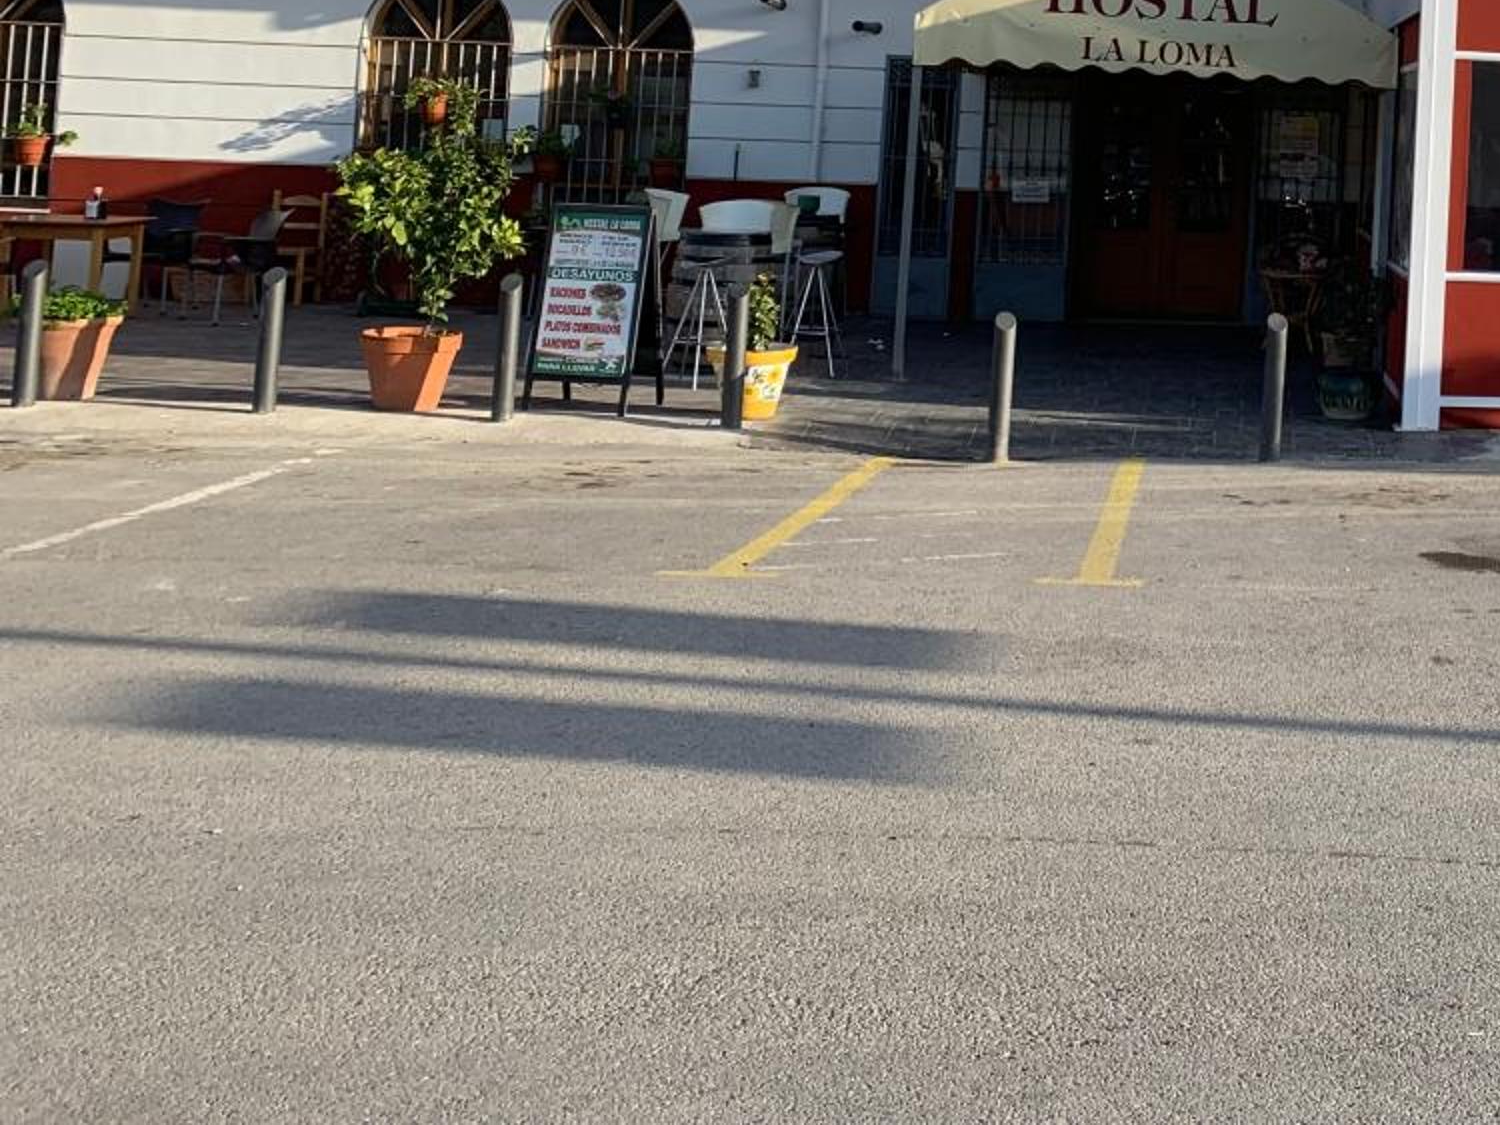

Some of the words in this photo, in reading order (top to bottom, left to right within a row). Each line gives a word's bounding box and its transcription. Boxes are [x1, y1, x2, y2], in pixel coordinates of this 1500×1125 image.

[1080, 36, 1125, 62] LA
[1137, 39, 1237, 68] LOMA
[552, 267, 633, 281] DESAYUNOS
[546, 303, 592, 316] BOCADILLOS
[544, 321, 571, 333] PLATOS
